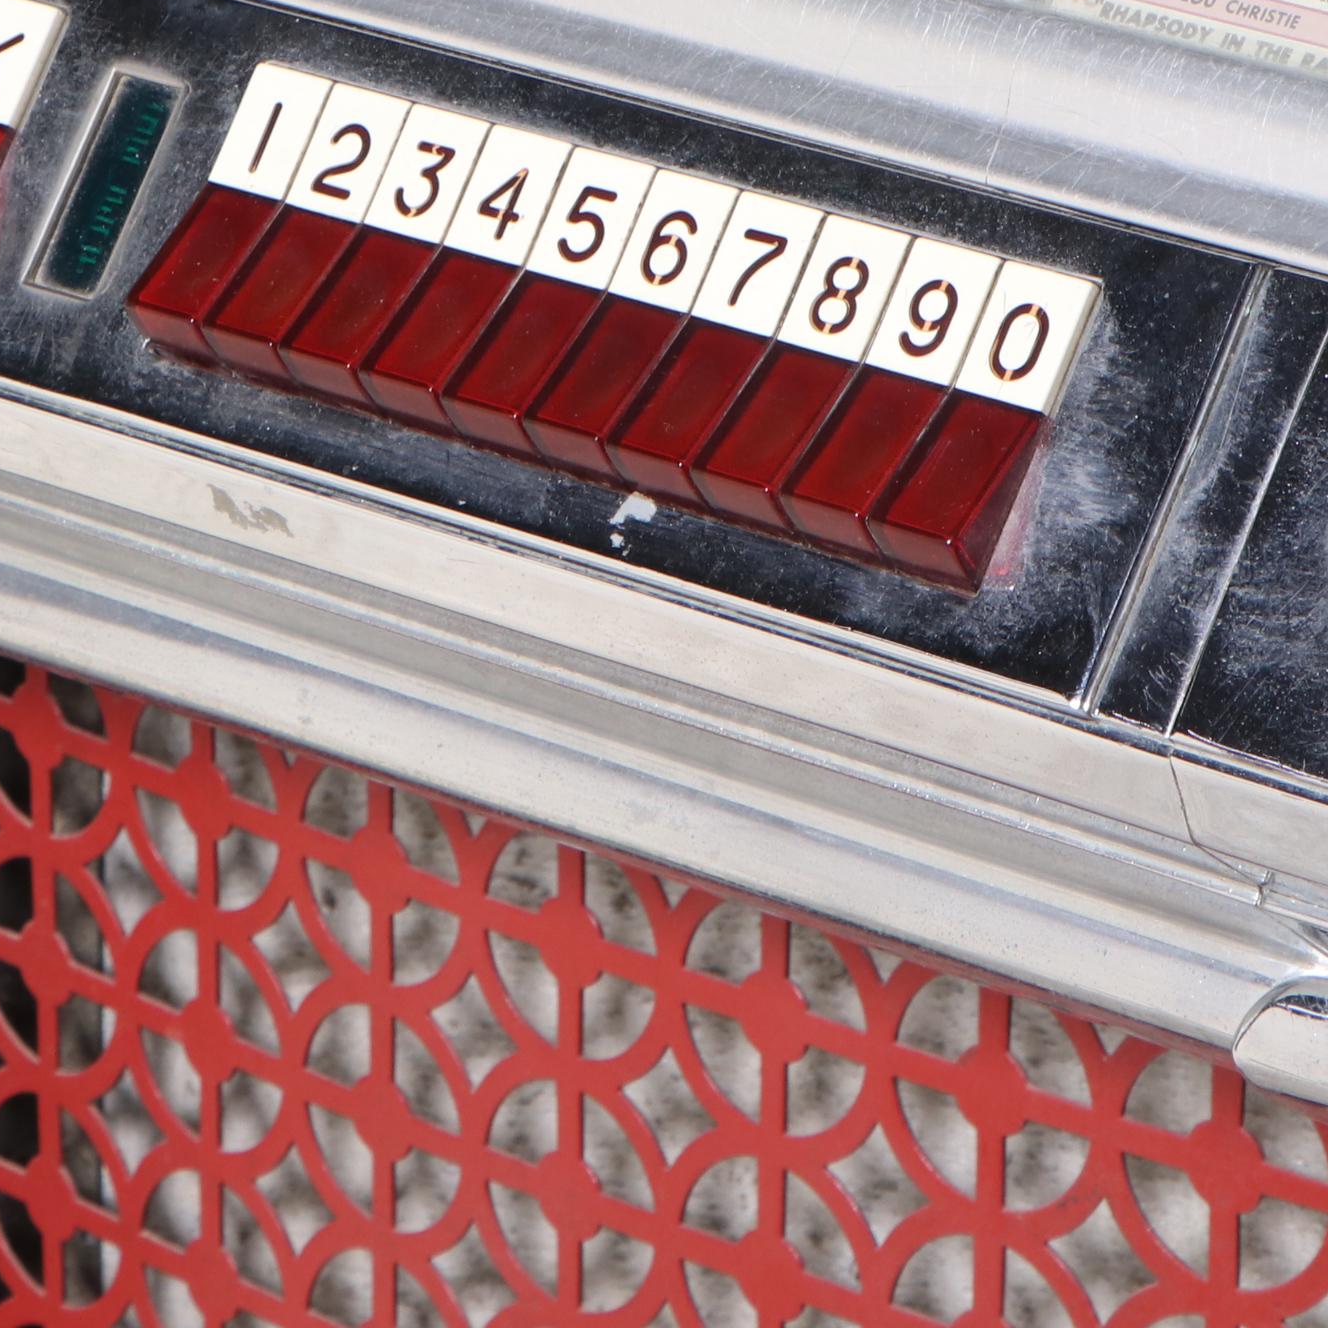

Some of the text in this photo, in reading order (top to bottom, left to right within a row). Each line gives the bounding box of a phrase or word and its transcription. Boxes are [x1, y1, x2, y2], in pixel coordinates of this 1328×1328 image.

[249, 102, 1050, 381] 1 2 3 4 5 6 7 8 9 0
